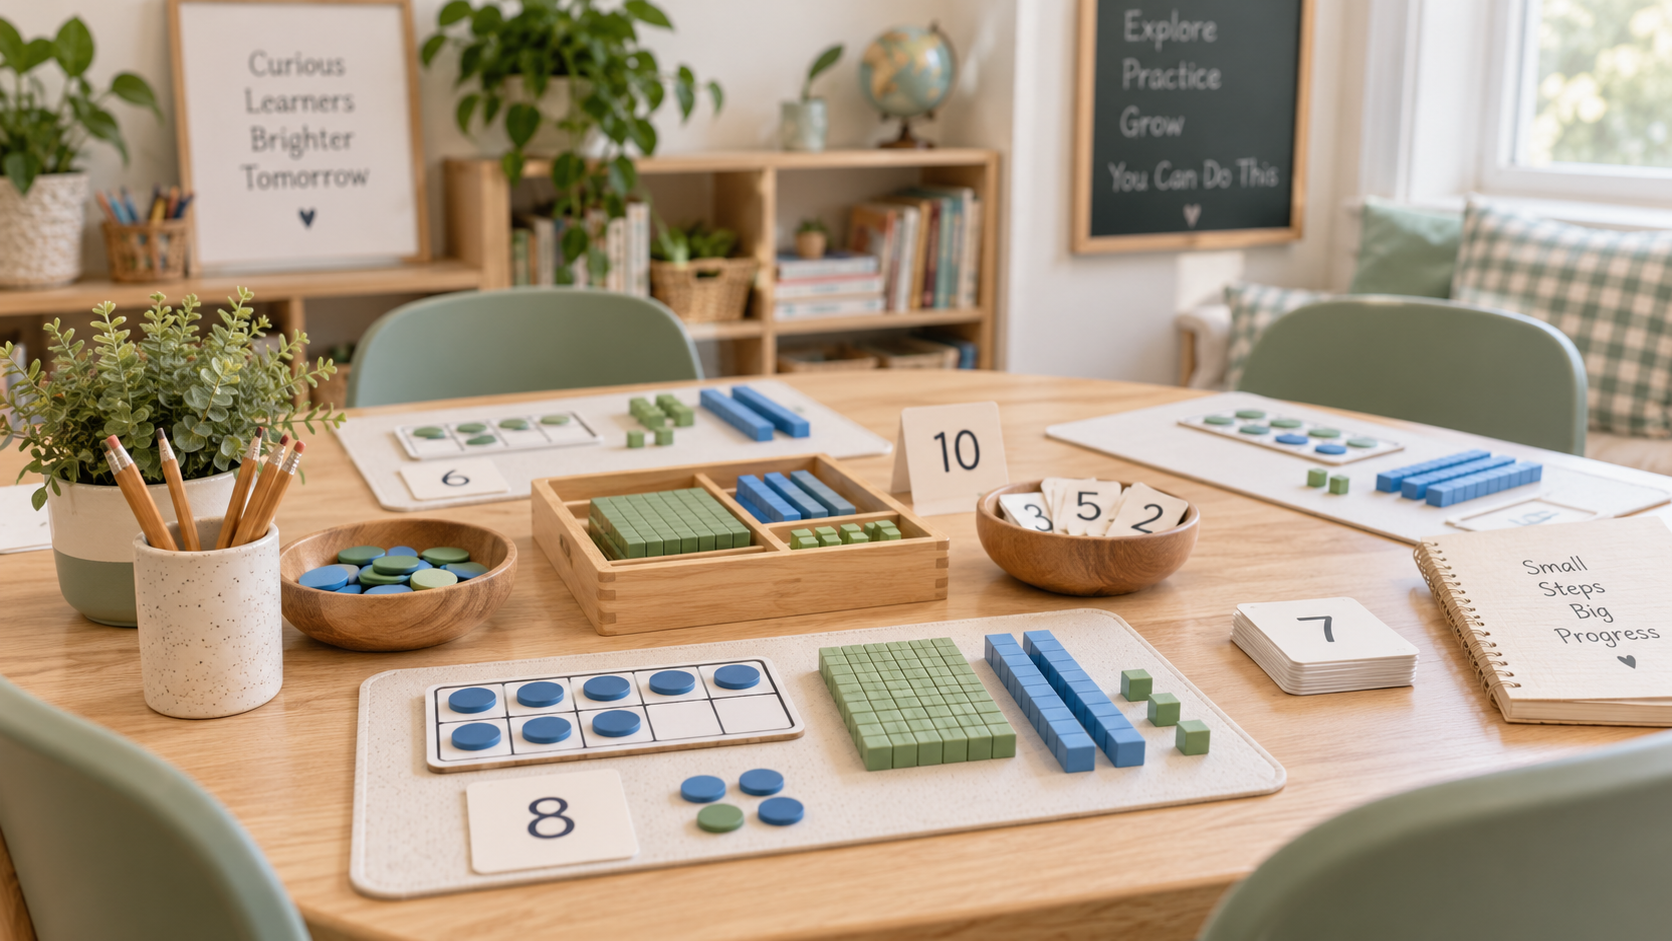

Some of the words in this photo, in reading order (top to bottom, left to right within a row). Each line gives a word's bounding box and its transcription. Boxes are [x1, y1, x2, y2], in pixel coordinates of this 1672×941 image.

[1124, 8, 1218, 52] Explore
[248, 49, 346, 78] Curious
[1122, 57, 1222, 91] Practice
[244, 86, 356, 115] Learners
[1119, 105, 1186, 138] Grow
[249, 124, 355, 161] Brighter
[240, 163, 371, 191] Tomorrow
[1107, 160, 1149, 193] You
[1153, 159, 1198, 191] Can
[1202, 158, 1233, 190] Do
[1235, 156, 1280, 188] This
[933, 428, 981, 473] 10
[441, 469, 470, 487] 6
[1024, 503, 1053, 532] 3
[1076, 491, 1101, 521] 5
[1130, 503, 1164, 534] 2
[1522, 555, 1588, 576] Small
[1538, 581, 1606, 600] Steps
[1569, 603, 1614, 623] Big
[1296, 615, 1335, 643] 7
[1553, 627, 1661, 648] Progress
[527, 796, 576, 839] 8
